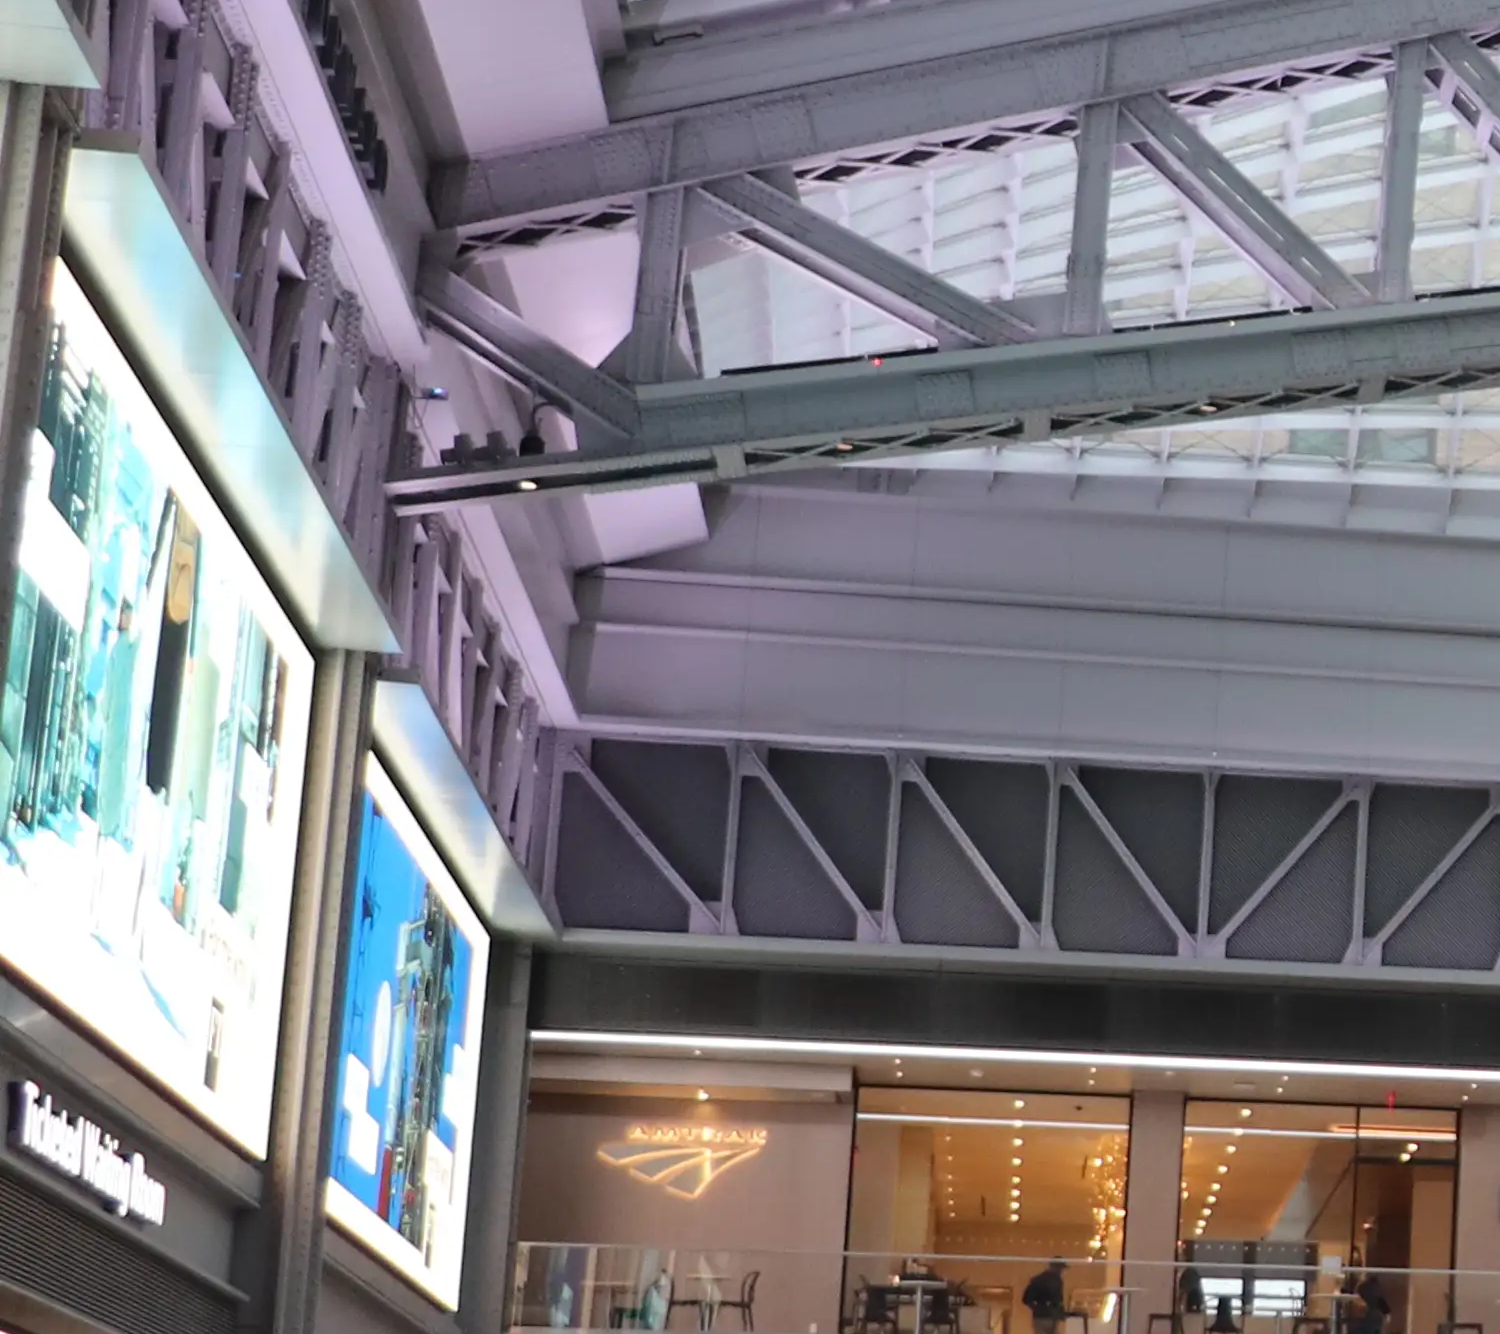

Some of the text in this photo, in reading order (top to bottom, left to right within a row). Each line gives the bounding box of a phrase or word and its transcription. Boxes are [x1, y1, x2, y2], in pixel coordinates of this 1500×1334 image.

[23, 1080, 165, 1227] Ticketed Waiting Room
